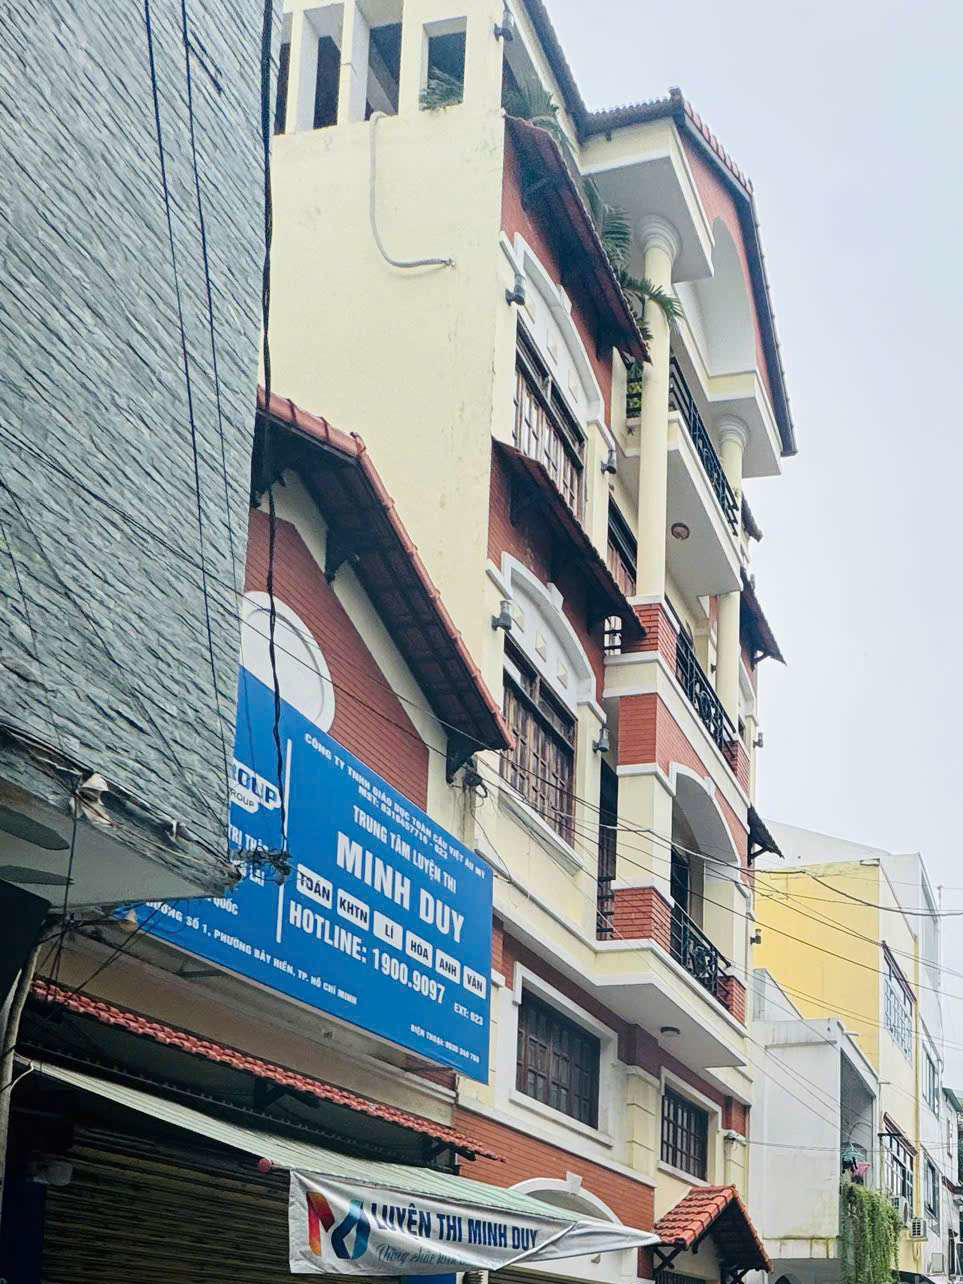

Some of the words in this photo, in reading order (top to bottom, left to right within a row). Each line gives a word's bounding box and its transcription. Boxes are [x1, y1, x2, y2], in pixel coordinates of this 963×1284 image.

[304, 732, 332, 760] CÔNG
[334, 754, 345, 770] TY
[347, 765, 370, 791] TNHH
[353, 804, 388, 844] TRUNG
[390, 831, 411, 861] TÂM
[413, 848, 441, 887] LUYỆN
[443, 871, 457, 894] THI
[336, 831, 411, 912] MINH
[419, 887, 465, 943] DUY
[186, 913, 199, 930] SỐ
[213, 930, 252, 955] PHƯỜNG
[289, 899, 367, 964] HOTLINE:
[373, 948, 446, 1004] 1900.9097
[300, 871, 331, 903] TOÁN
[339, 896, 368, 924] KHTN
[384, 922, 394, 939] LÍ
[439, 957, 457, 977] ANH
[467, 973, 483, 993] VĂN
[454, 1002, 469, 1018] EXT:
[436, 1212, 462, 1242] THI
[467, 1216, 508, 1249] MINH
[512, 1226, 539, 1251] DUY
